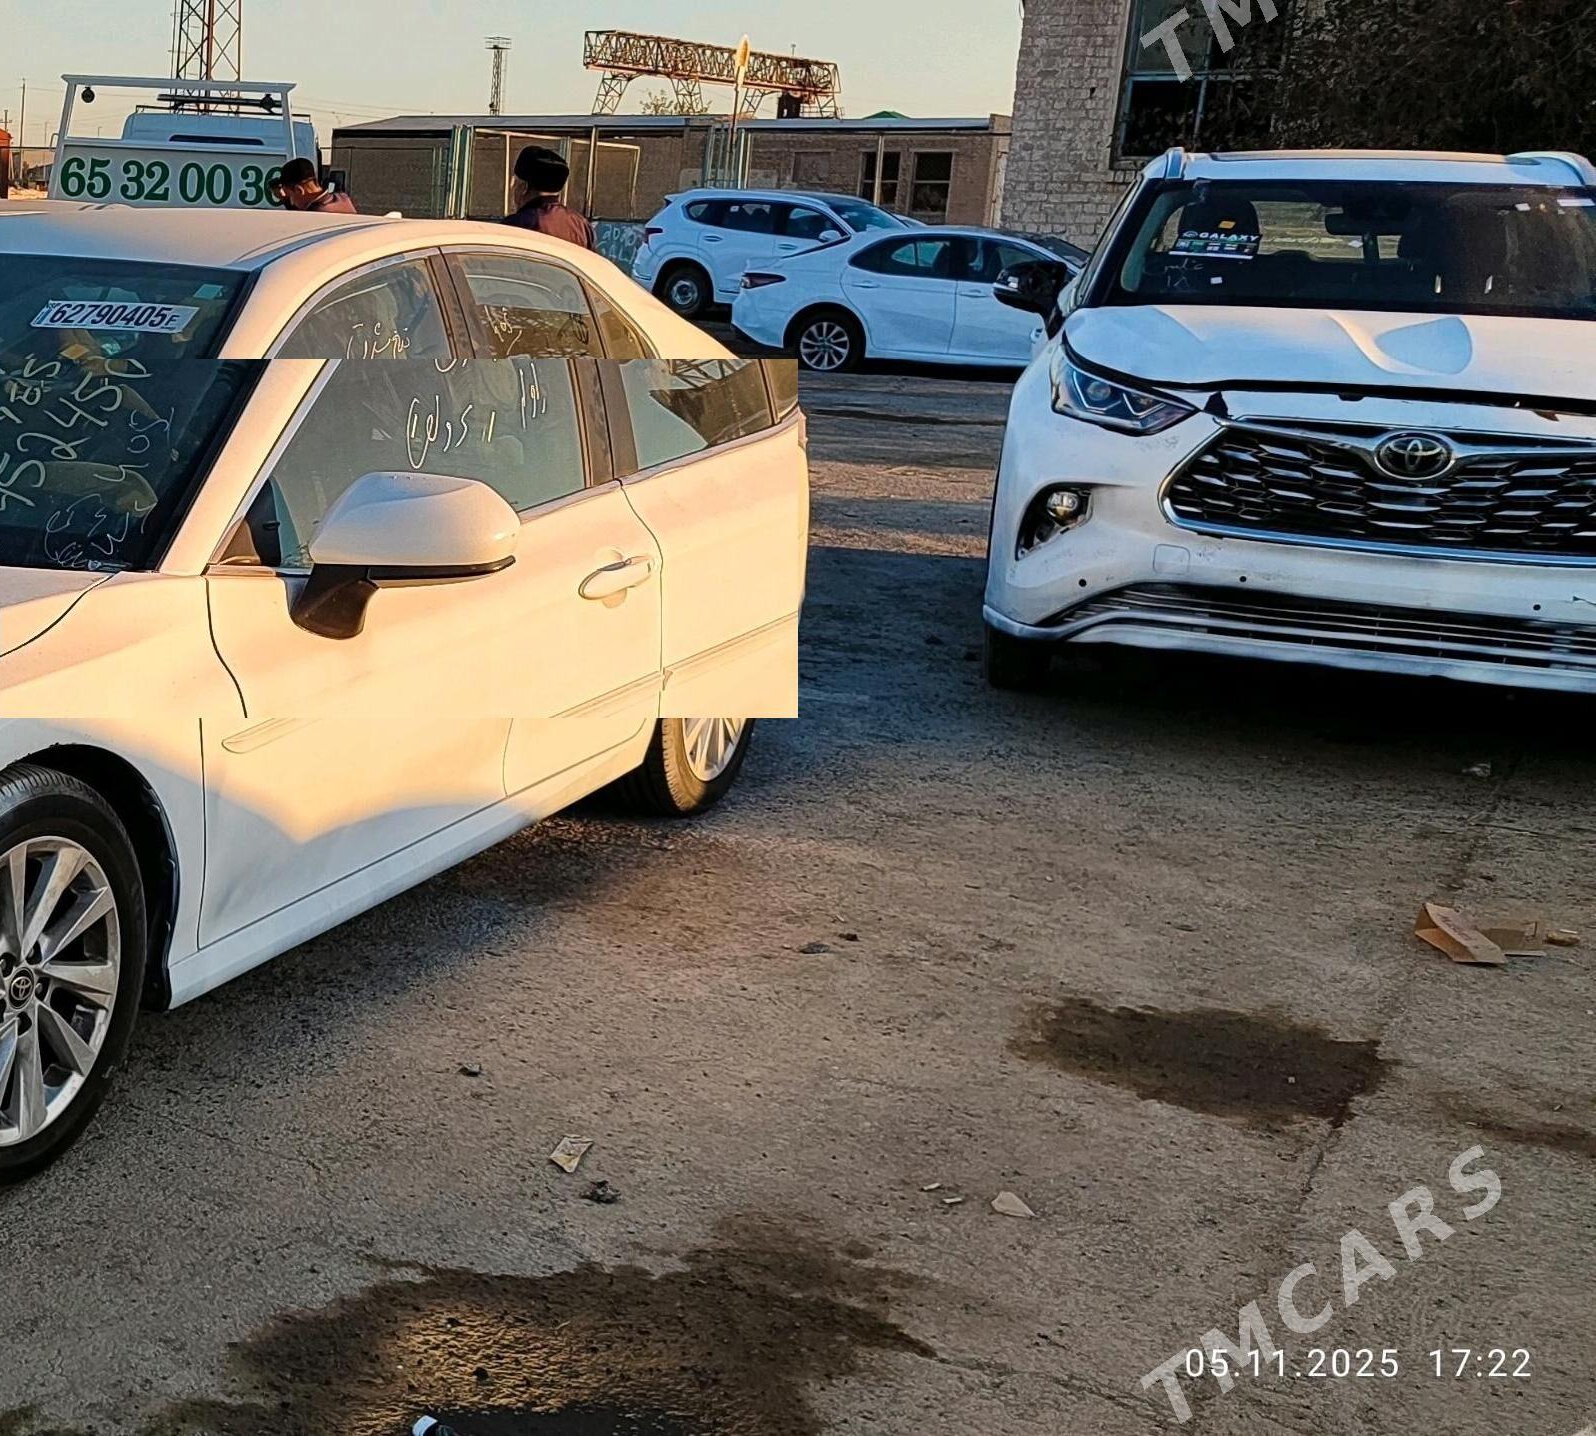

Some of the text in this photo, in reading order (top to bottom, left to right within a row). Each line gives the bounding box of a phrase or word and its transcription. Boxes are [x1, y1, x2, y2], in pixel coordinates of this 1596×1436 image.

[60, 157, 111, 198] 65
[120, 160, 170, 201] 32
[178, 162, 232, 205] 00
[1199, 231, 1260, 242] GALAXY
